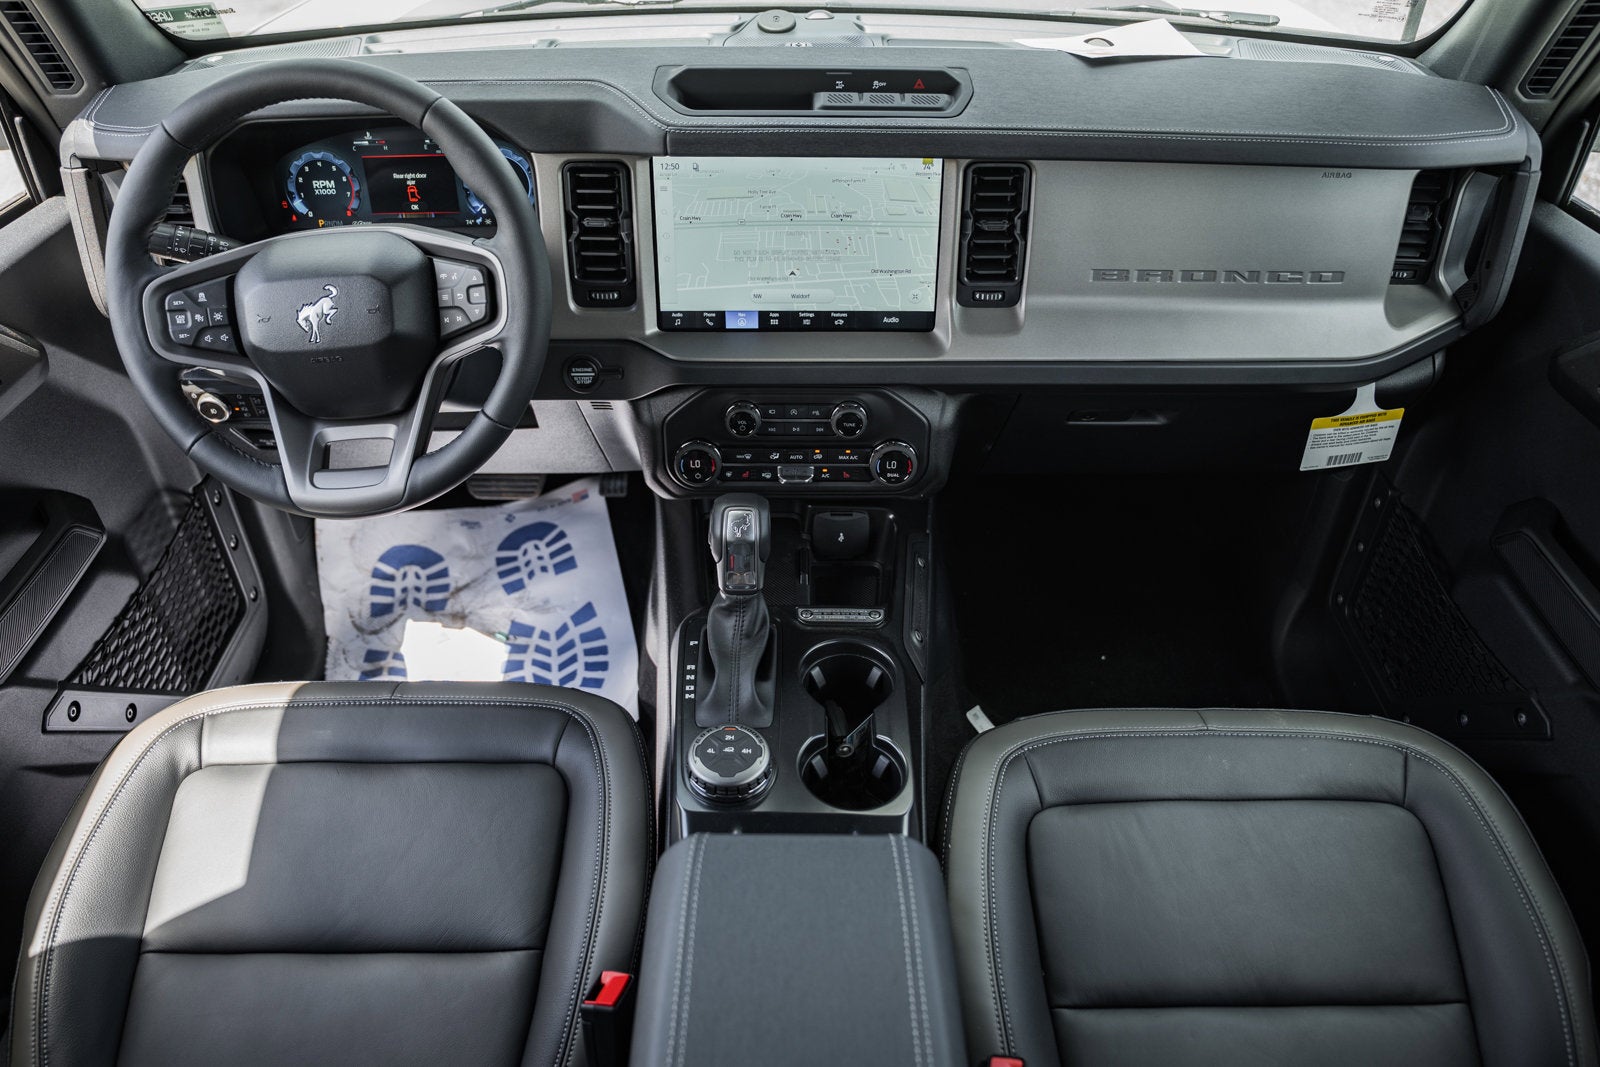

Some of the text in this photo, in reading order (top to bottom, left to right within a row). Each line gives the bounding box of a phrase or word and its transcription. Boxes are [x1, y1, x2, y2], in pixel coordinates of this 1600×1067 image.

[312, 180, 335, 188] RPM
[1089, 268, 1346, 284] BRONCO
[690, 460, 701, 468] LO
[886, 461, 896, 469] LO
